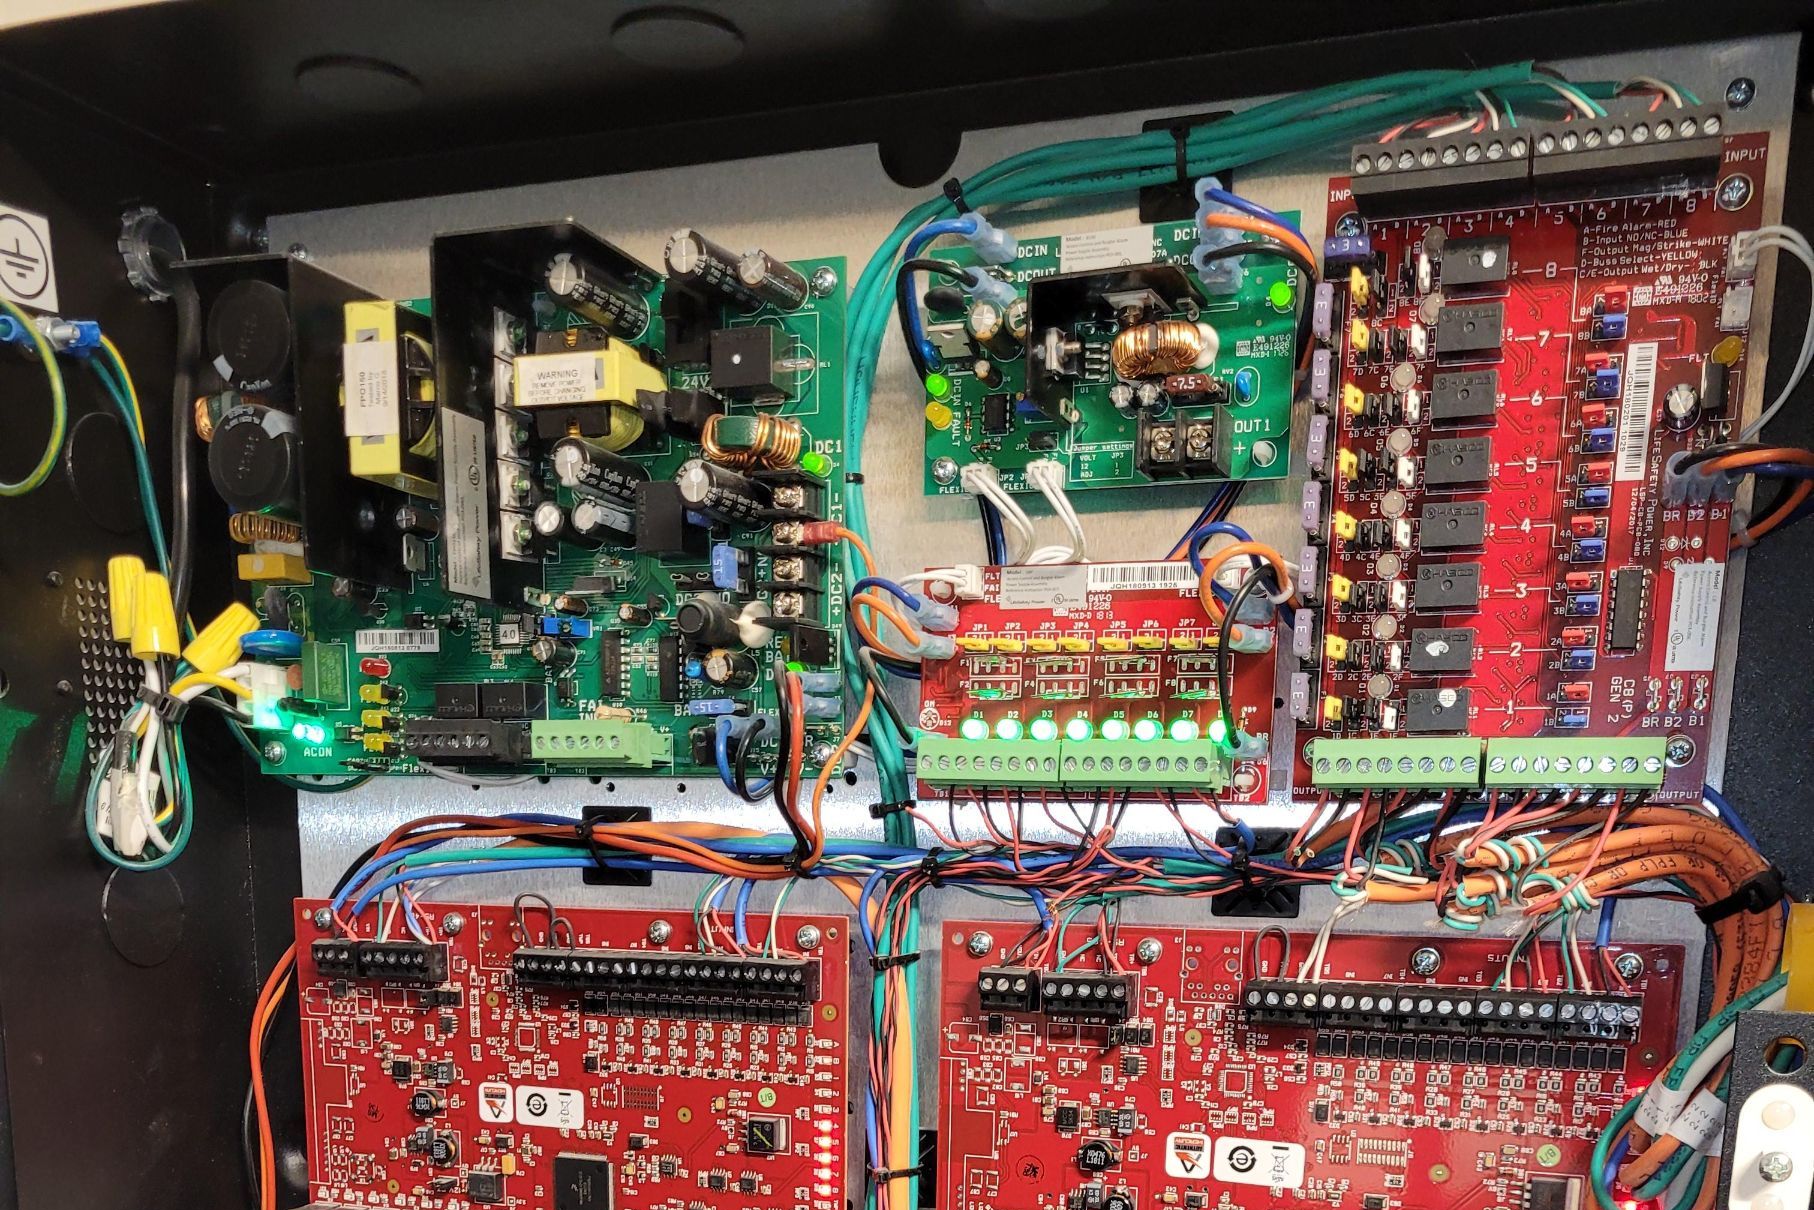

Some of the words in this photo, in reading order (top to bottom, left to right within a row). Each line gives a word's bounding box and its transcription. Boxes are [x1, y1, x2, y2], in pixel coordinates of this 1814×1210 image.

[1725, 148, 1766, 162] INPUT
[1642, 203, 1651, 216] 7
[1686, 199, 1696, 212] 8
[1554, 212, 1563, 224] 5
[1597, 207, 1606, 220] 6
[1464, 219, 1473, 232] 3
[1505, 215, 1514, 228] 4
[1018, 245, 1048, 258] DCIN
[1545, 262, 1557, 278] 8
[1538, 330, 1549, 347] 7
[1578, 331, 1590, 340] 8B
[537, 369, 578, 380] WARNING
[682, 376, 710, 389] 24V
[1531, 391, 1542, 406] 6
[1573, 392, 1584, 400] 7B
[951, 411, 961, 447] FAULT
[815, 440, 842, 454] DC1
[1525, 457, 1537, 473] 5
[1565, 475, 1576, 483] 5A
[1663, 510, 1680, 521] BR
[1520, 519, 1531, 533] 4
[1560, 529, 1571, 537] 4A
[1515, 583, 1527, 598] 3
[1554, 607, 1565, 615] 3B
[973, 623, 988, 632] JP1
[1005, 622, 1020, 630] JP2
[1073, 622, 1089, 630] JP4
[1143, 620, 1159, 628] JP6
[1179, 619, 1195, 627] JP7
[1551, 638, 1561, 646] 2A
[1510, 643, 1521, 657] 2
[1610, 676, 1622, 703] GEN
[1506, 700, 1515, 714] 1
[1642, 716, 1659, 728] BR
[1664, 716, 1681, 728] B2
[1688, 716, 1704, 726] B1
